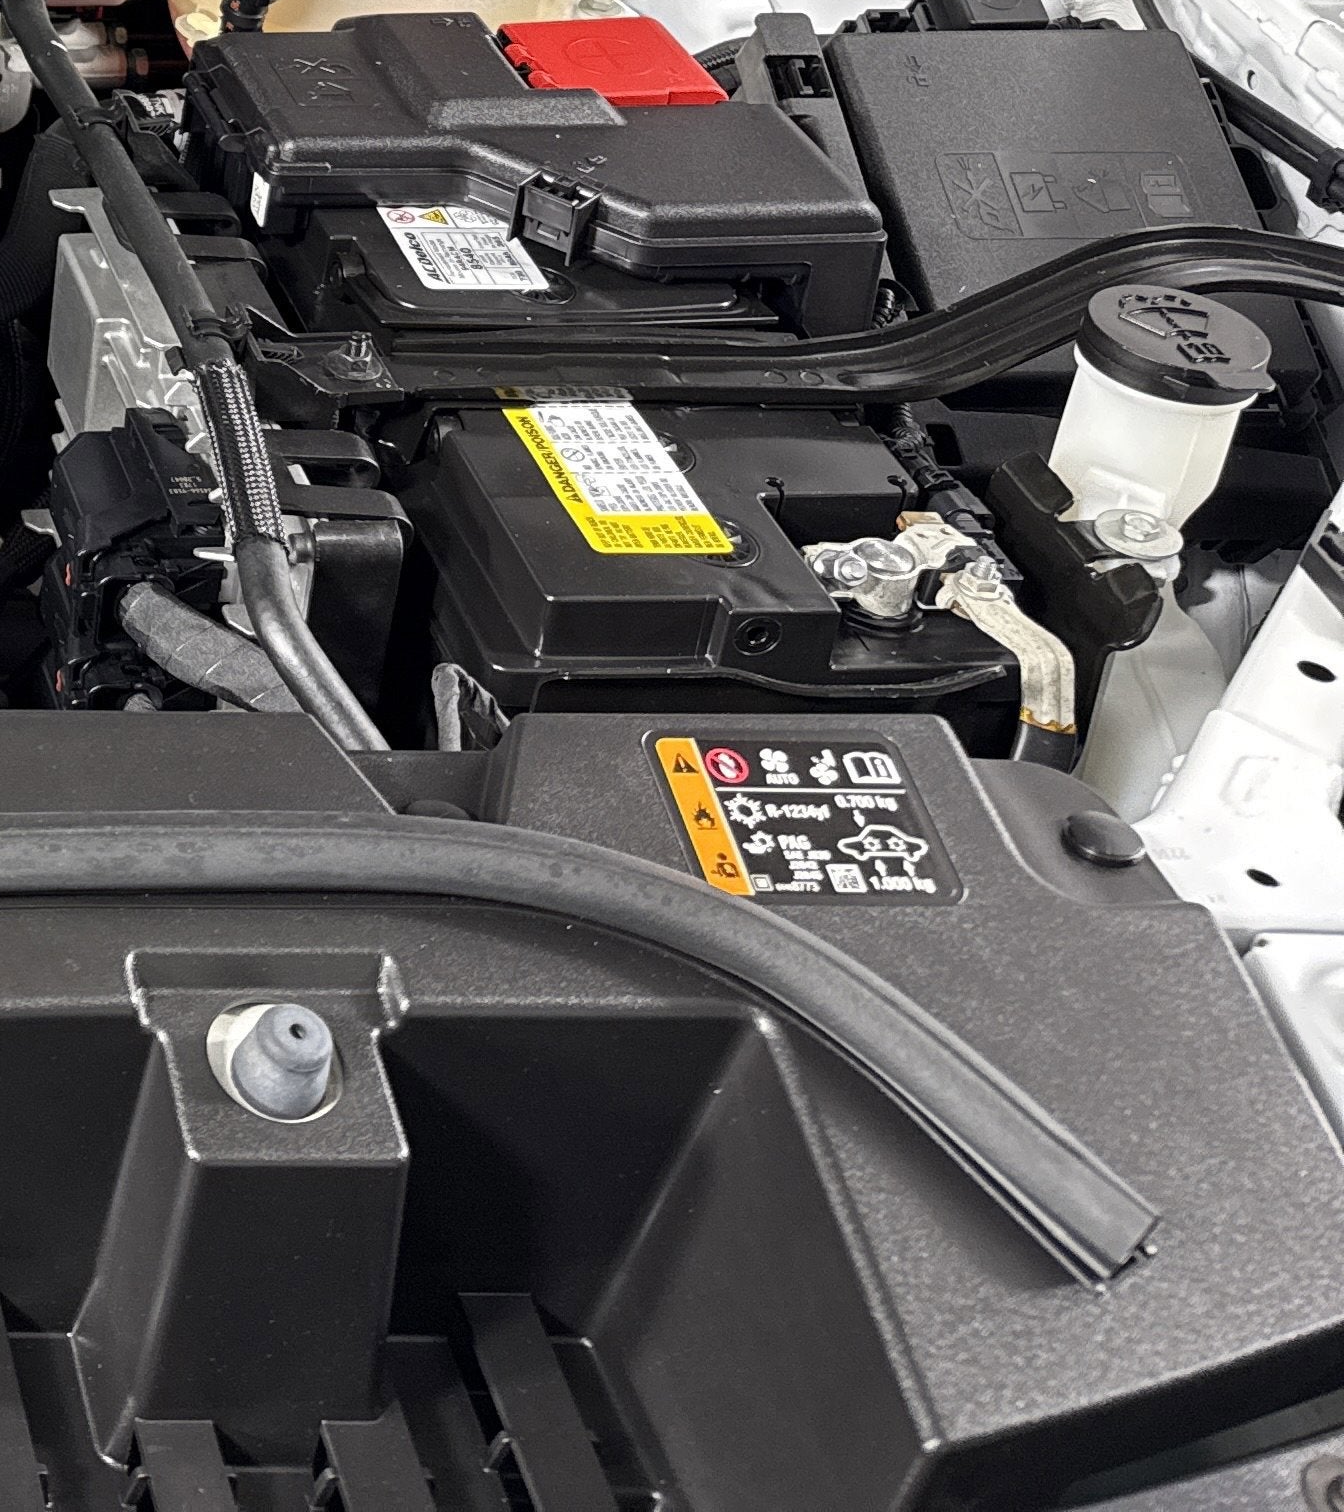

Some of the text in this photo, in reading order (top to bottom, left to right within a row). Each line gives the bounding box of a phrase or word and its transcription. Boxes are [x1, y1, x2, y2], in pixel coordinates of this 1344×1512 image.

[404, 231, 444, 283] ACDelco
[765, 772, 800, 785] AUTO
[765, 803, 831, 821] R-1234yf
[834, 794, 899, 812] 0.700 kg
[777, 834, 812, 850] PAG
[912, 876, 937, 894] kg
